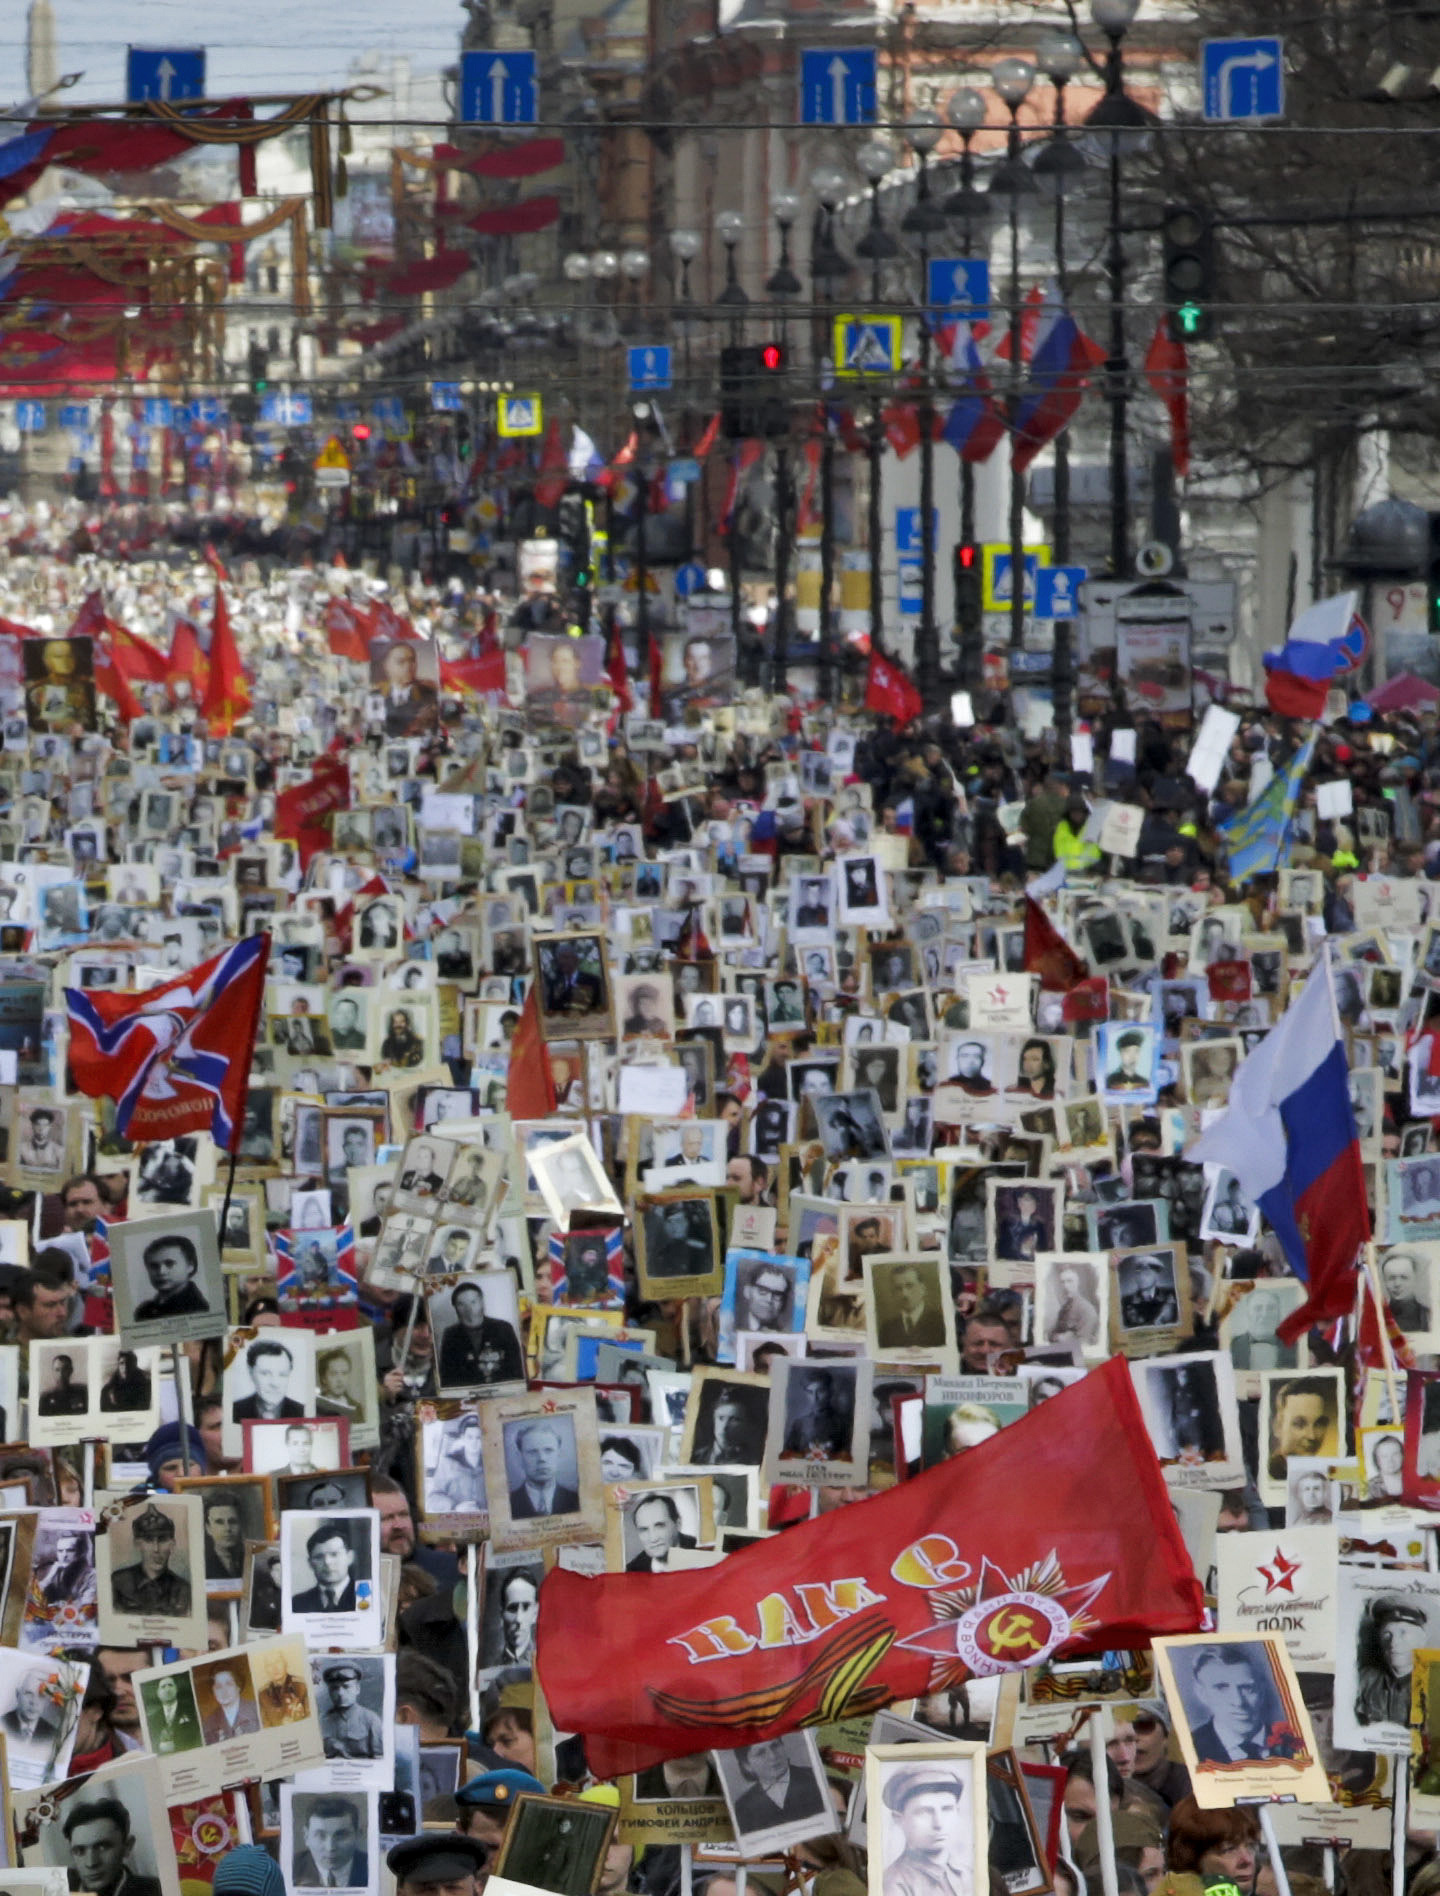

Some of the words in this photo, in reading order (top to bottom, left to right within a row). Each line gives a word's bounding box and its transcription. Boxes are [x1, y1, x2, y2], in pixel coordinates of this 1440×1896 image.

[942, 1390, 1014, 1403] НИКИФОРОВ
[1236, 1593, 1330, 1619] бессмертный
[1257, 1616, 1305, 1632] ПОЛК
[655, 1804, 716, 1817] КОЛЬЦОВ
[620, 1817, 678, 1830] ТИМОФЕЙ
